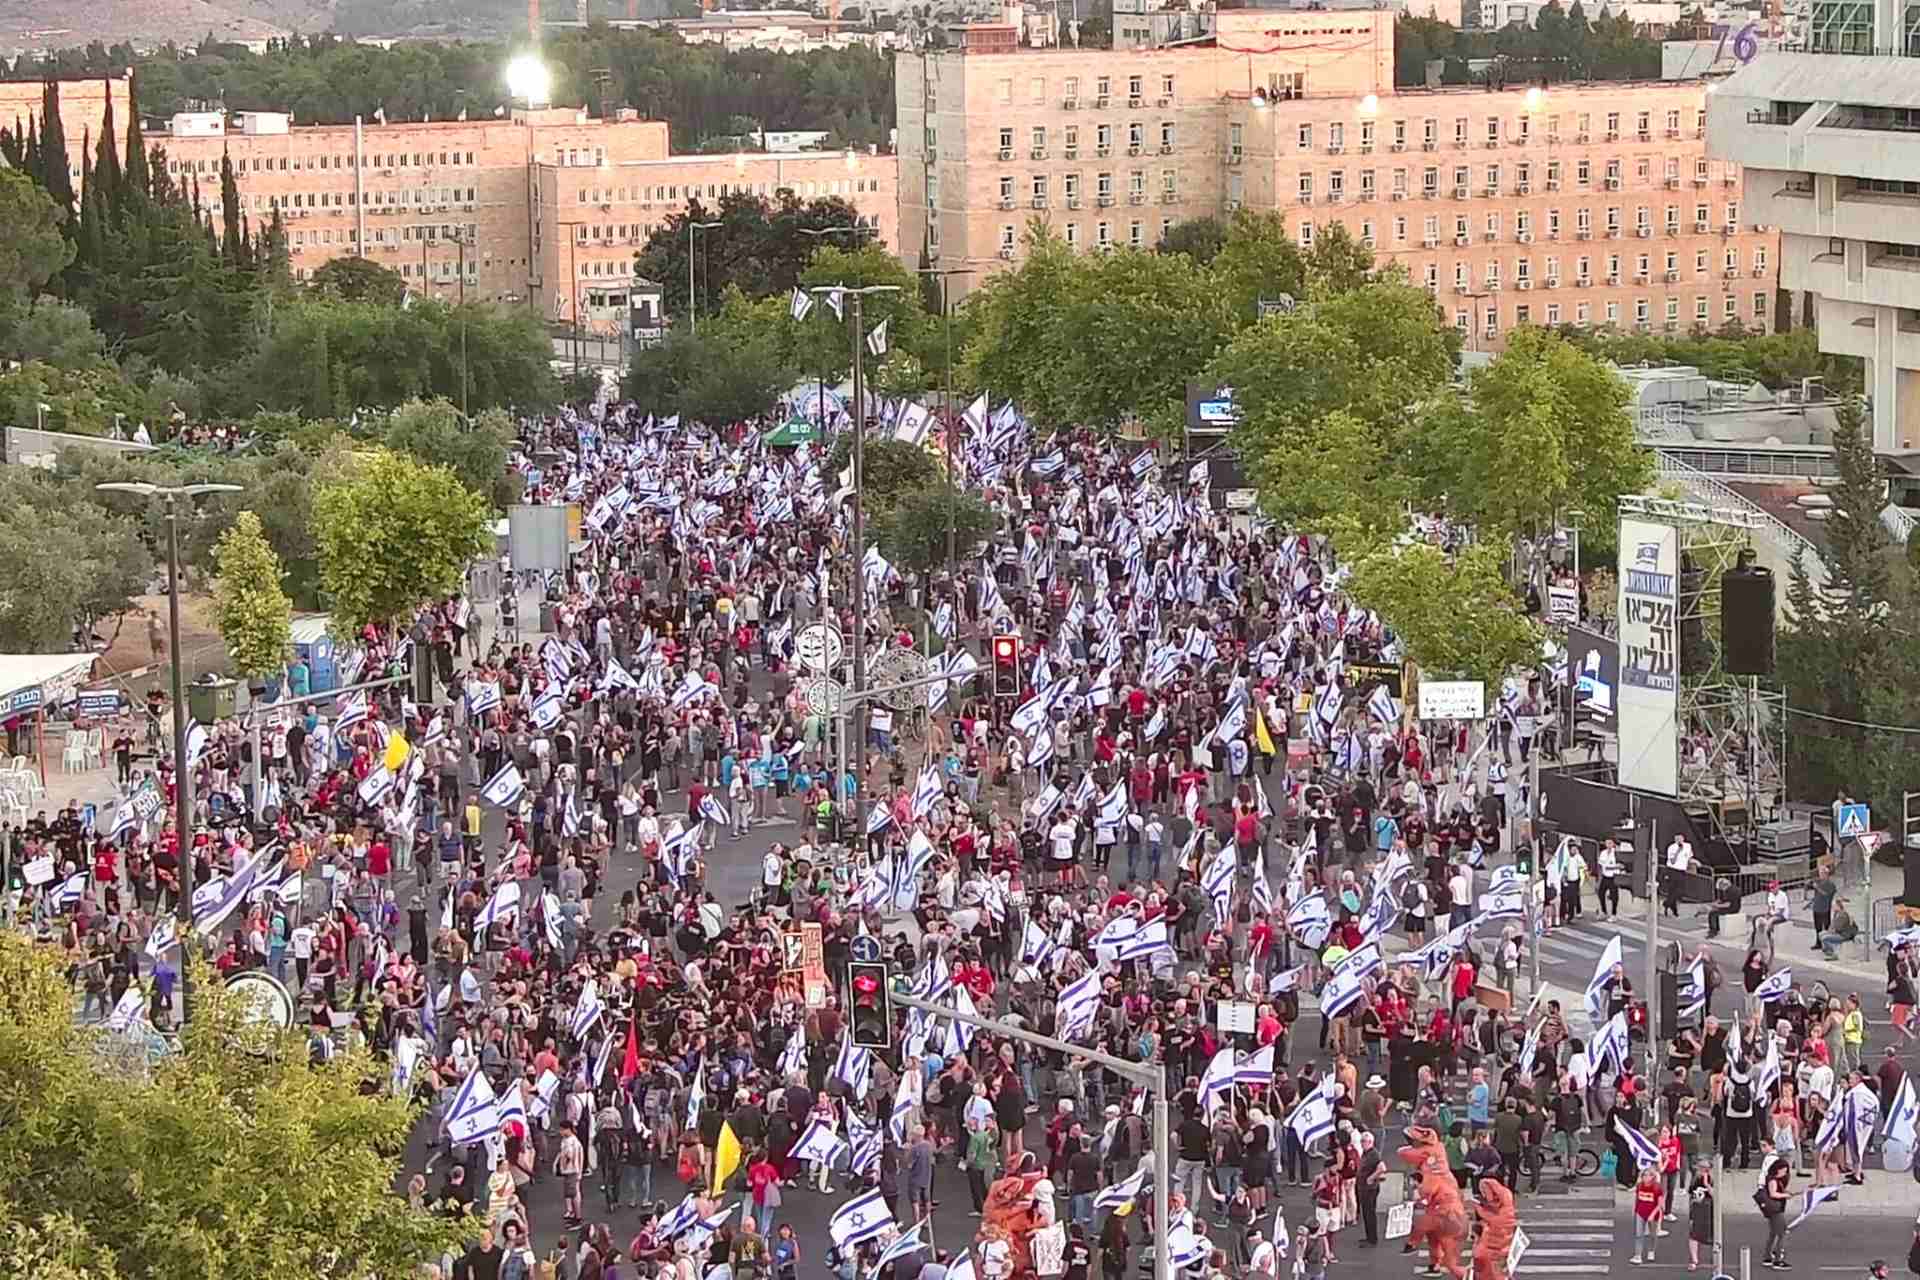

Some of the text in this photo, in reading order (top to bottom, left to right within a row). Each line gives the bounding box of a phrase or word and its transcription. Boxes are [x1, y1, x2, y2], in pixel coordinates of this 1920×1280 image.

[1711, 24, 1758, 64] 76
[1625, 597, 1673, 627] מכאן
[1650, 625, 1673, 652] זה
[1626, 645, 1674, 673] עלינו
